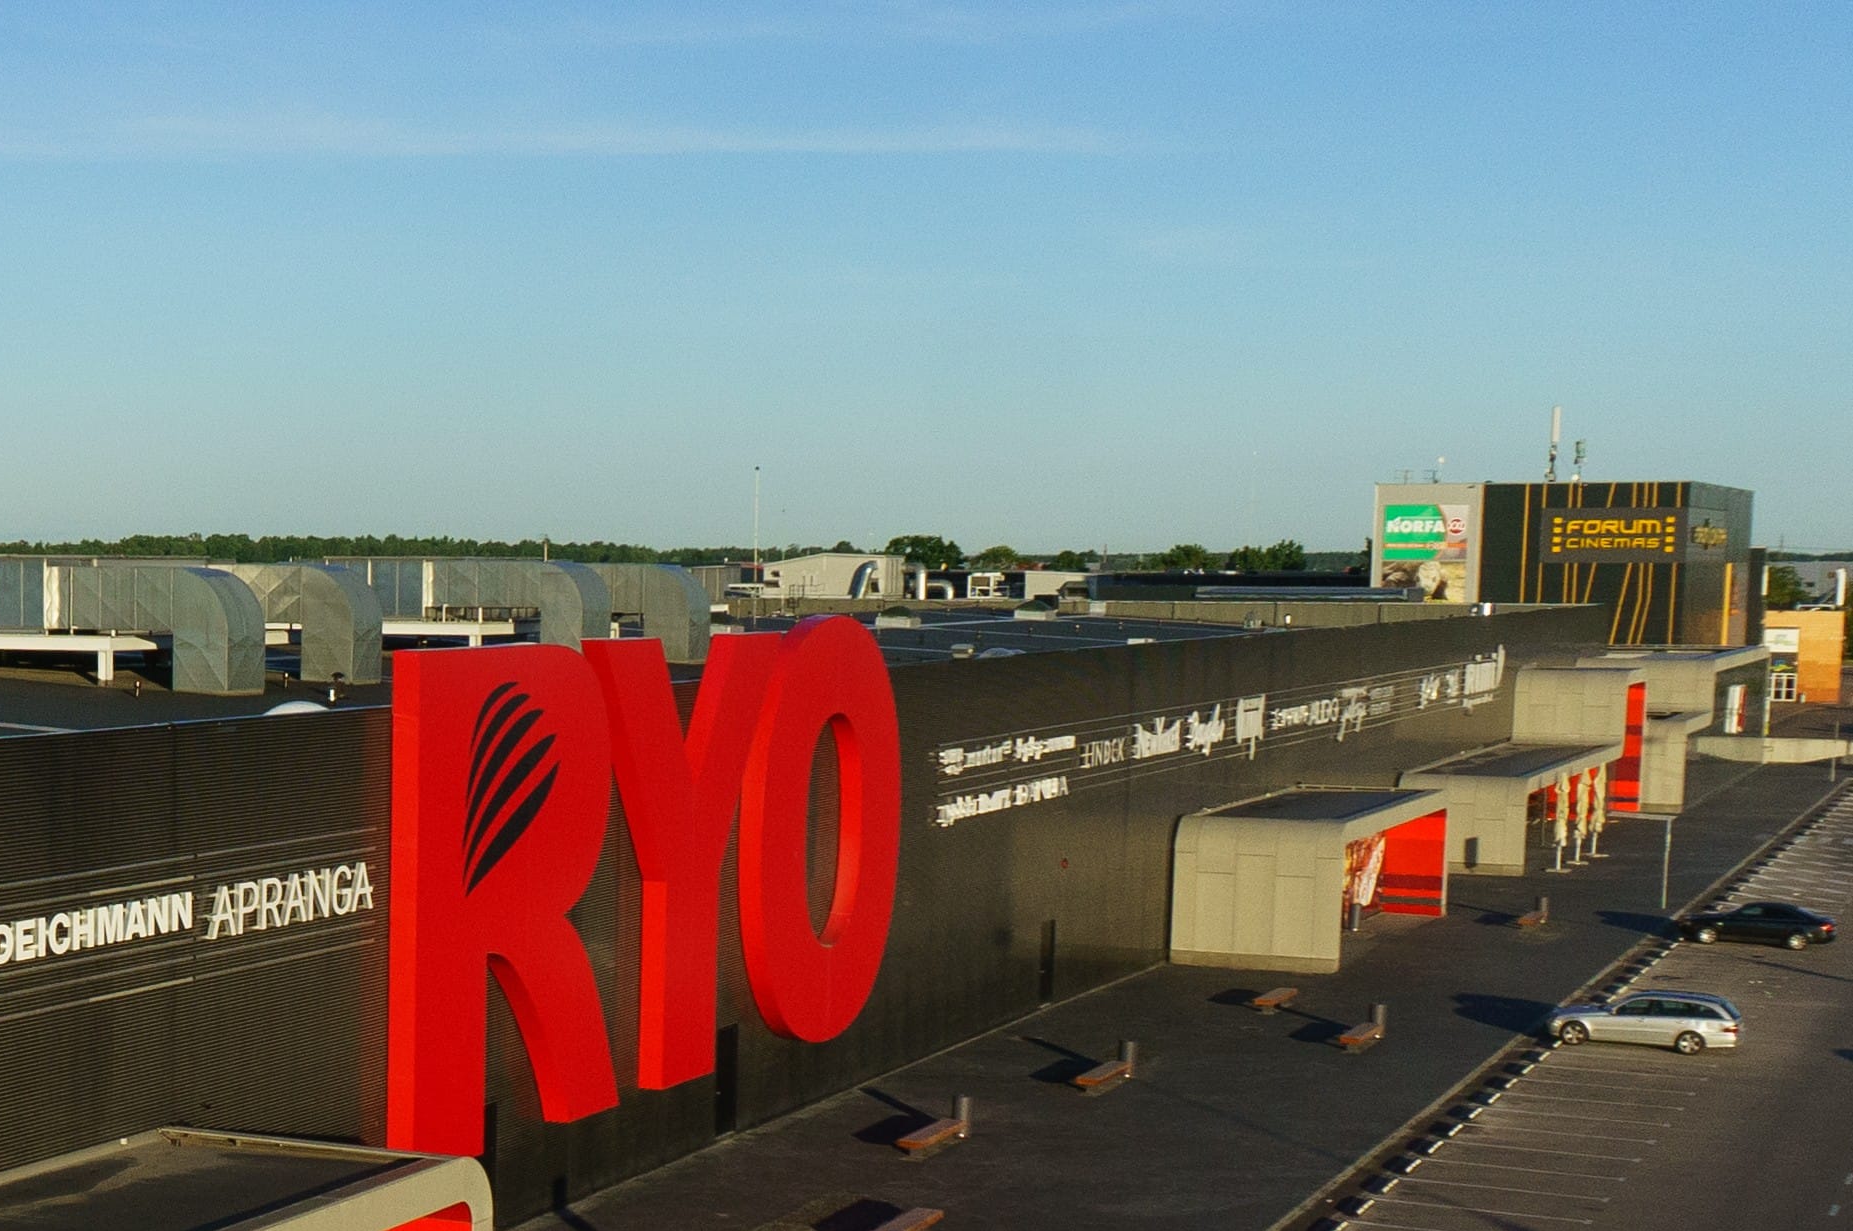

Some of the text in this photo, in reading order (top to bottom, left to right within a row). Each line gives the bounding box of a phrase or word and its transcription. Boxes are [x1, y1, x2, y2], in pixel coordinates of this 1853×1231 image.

[1386, 517, 1446, 533] NORFA
[1565, 519, 1662, 535] FORUM
[1565, 537, 1661, 549] CINEMAS
[1081, 737, 1126, 768] LINDEX
[387, 615, 899, 1156] RYO
[203, 861, 375, 940] APRANGA
